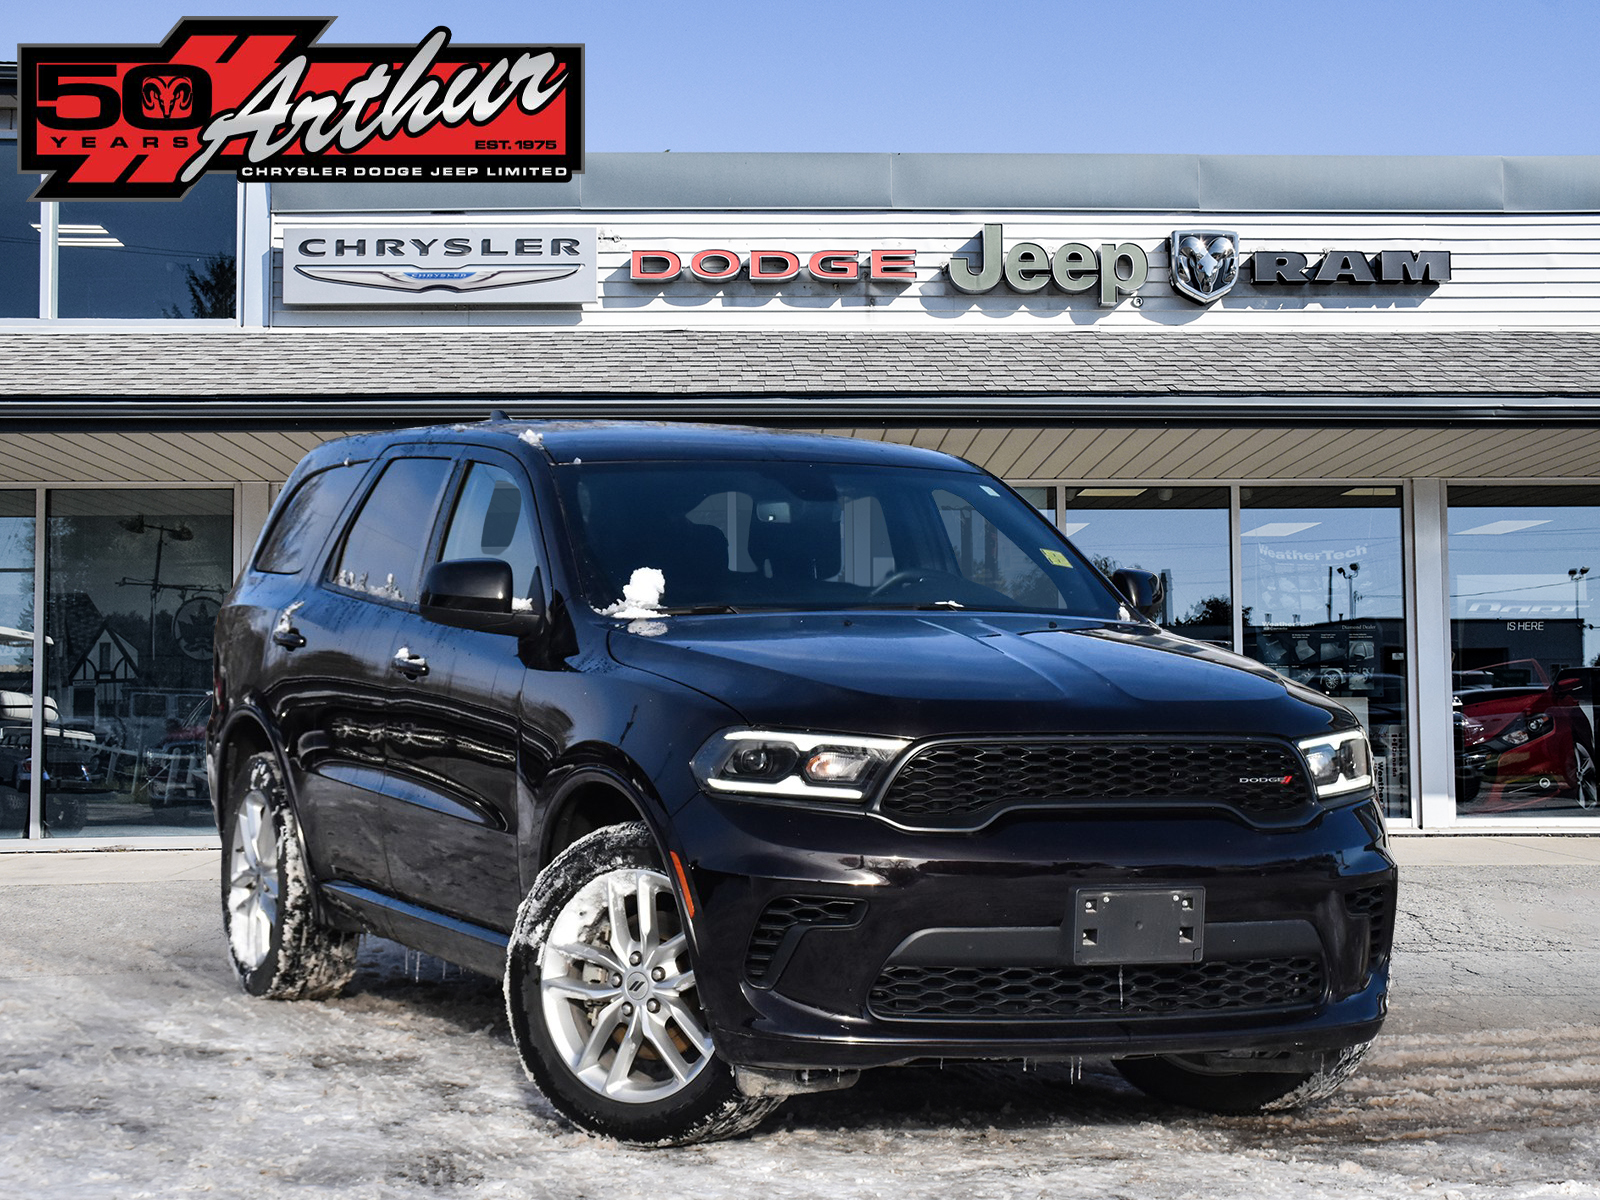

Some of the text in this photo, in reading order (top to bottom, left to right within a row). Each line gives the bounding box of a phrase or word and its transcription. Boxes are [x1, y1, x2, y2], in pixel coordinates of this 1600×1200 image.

[298, 238, 581, 257] CHRYSLER
[630, 249, 918, 284] DODGE
[948, 223, 1149, 307] Jeep
[1250, 250, 1452, 286] RAM
[1258, 543, 1367, 560] WeatherTech
[1506, 621, 1545, 631] IS HERE
